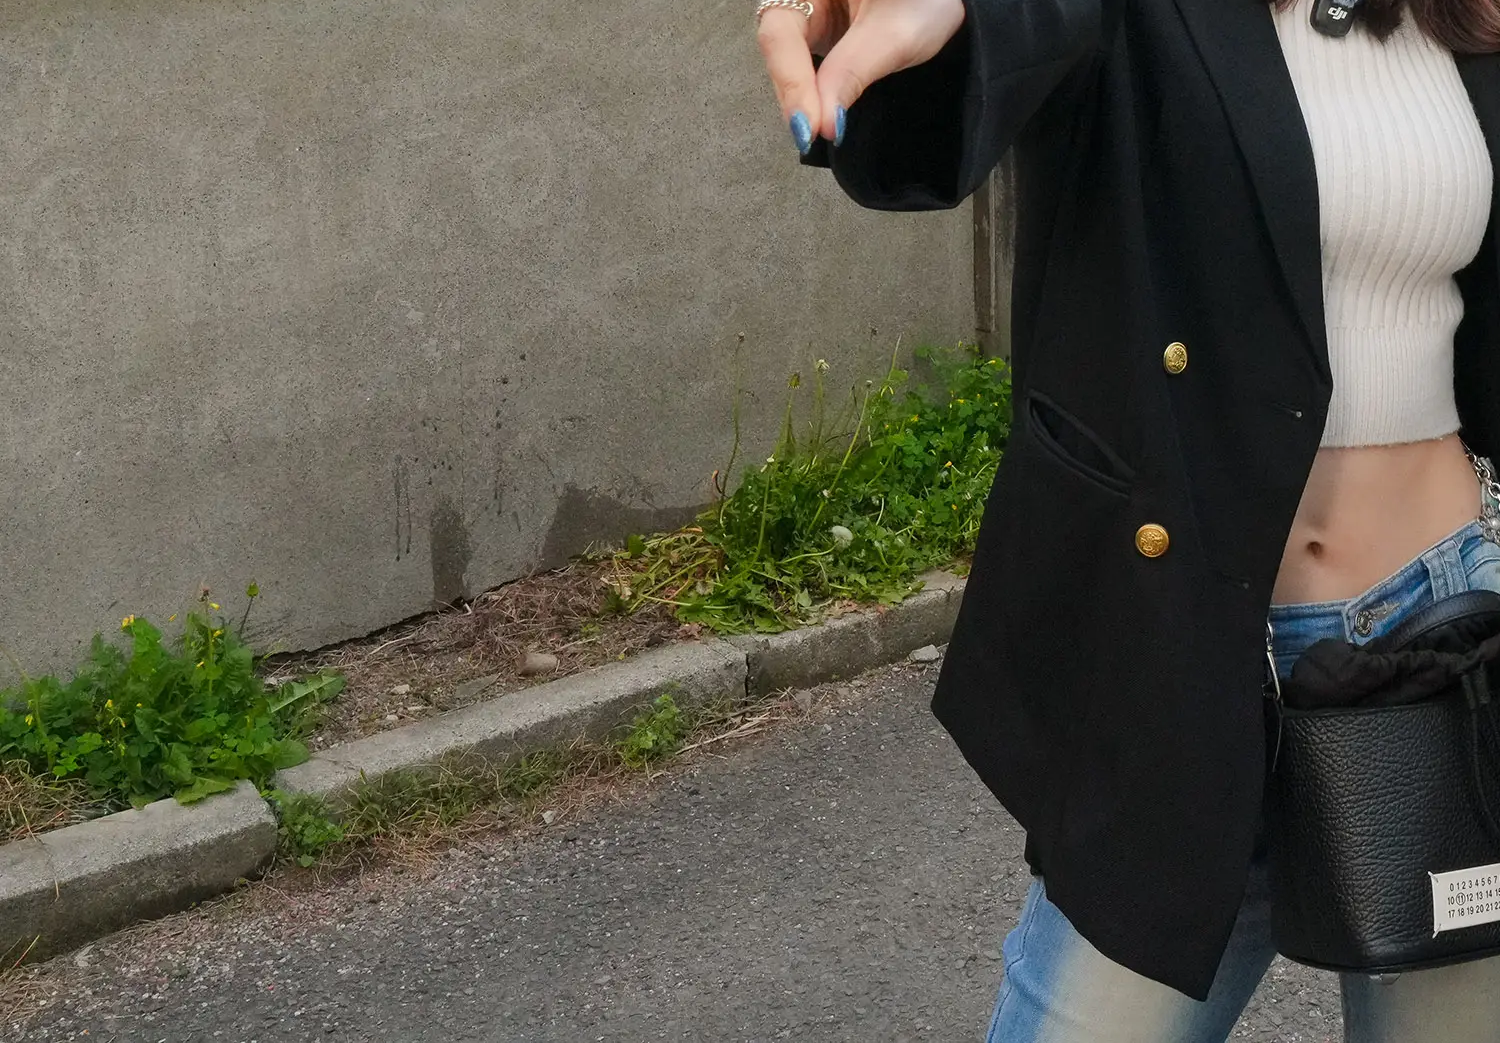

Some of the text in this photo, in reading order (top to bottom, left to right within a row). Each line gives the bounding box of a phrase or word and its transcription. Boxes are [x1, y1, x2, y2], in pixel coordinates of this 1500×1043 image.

[1447, 897, 1455, 905] 10
[1457, 895, 1464, 903] 11
[1466, 893, 1474, 902] 12
[1476, 892, 1483, 900] 13
[1486, 890, 1493, 898] 14
[1448, 910, 1455, 918] 17
[1457, 908, 1465, 917] 18
[1466, 906, 1474, 915] 19
[1475, 904, 1484, 914] 20
[1485, 903, 1494, 912] 21
